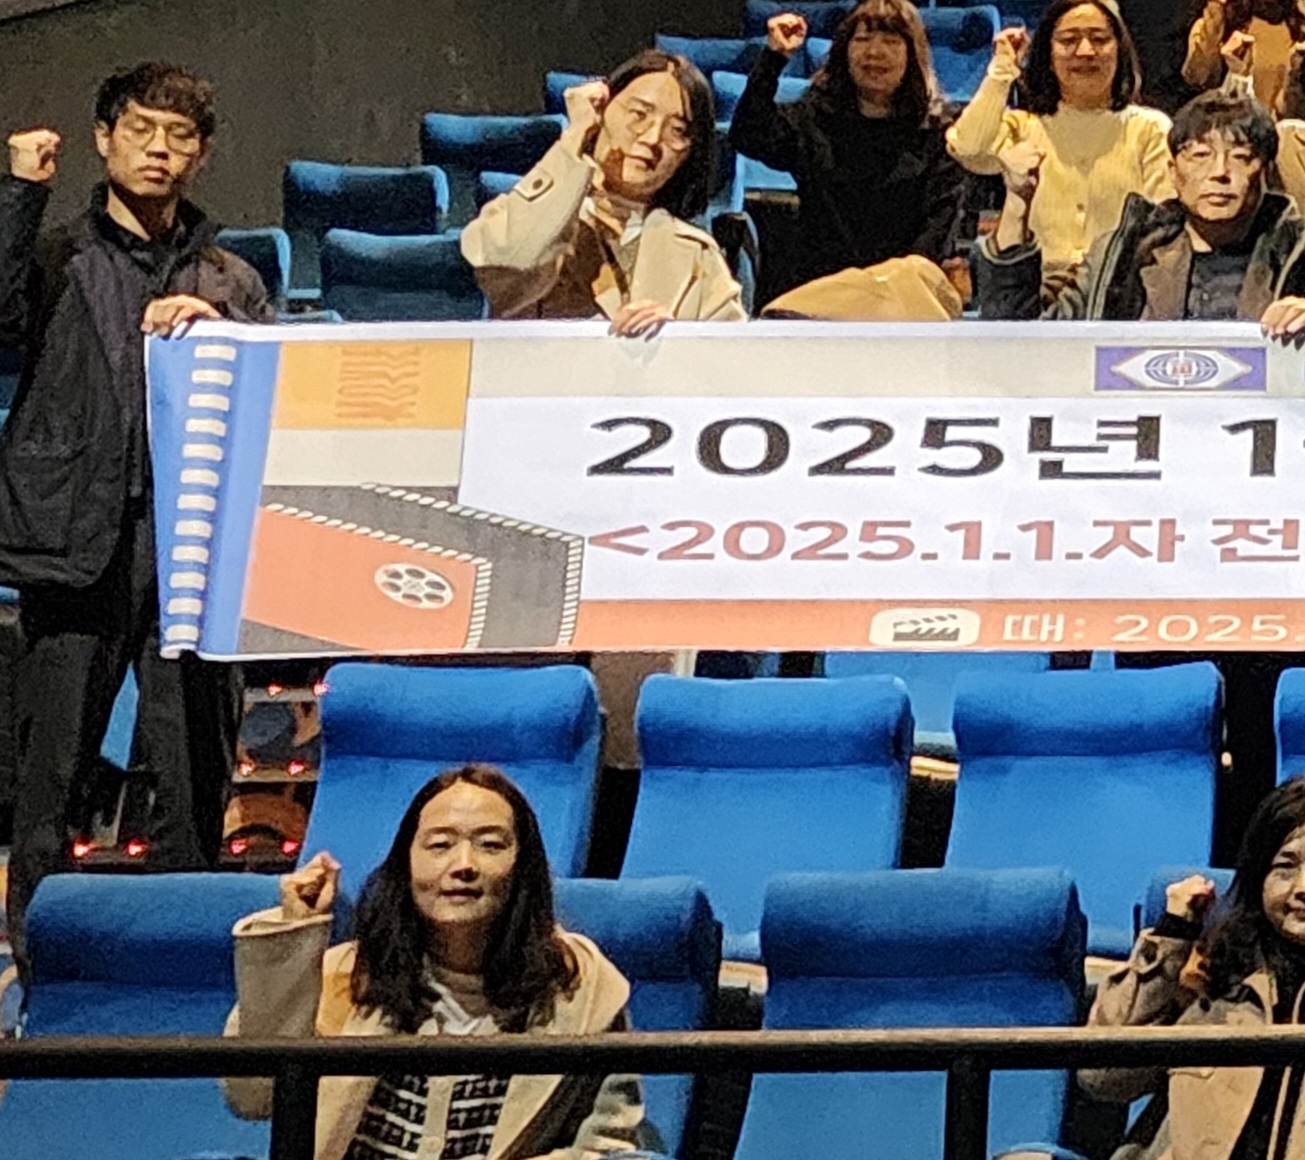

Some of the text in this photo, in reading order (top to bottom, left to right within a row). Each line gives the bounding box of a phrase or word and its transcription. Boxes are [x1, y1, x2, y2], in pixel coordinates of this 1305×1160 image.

[587, 416, 1163, 480] 2025년
[587, 519, 1184, 563] <2025.1.1.자
[1003, 613, 1086, 642] 때:
[1112, 614, 1305, 643] 2025.
